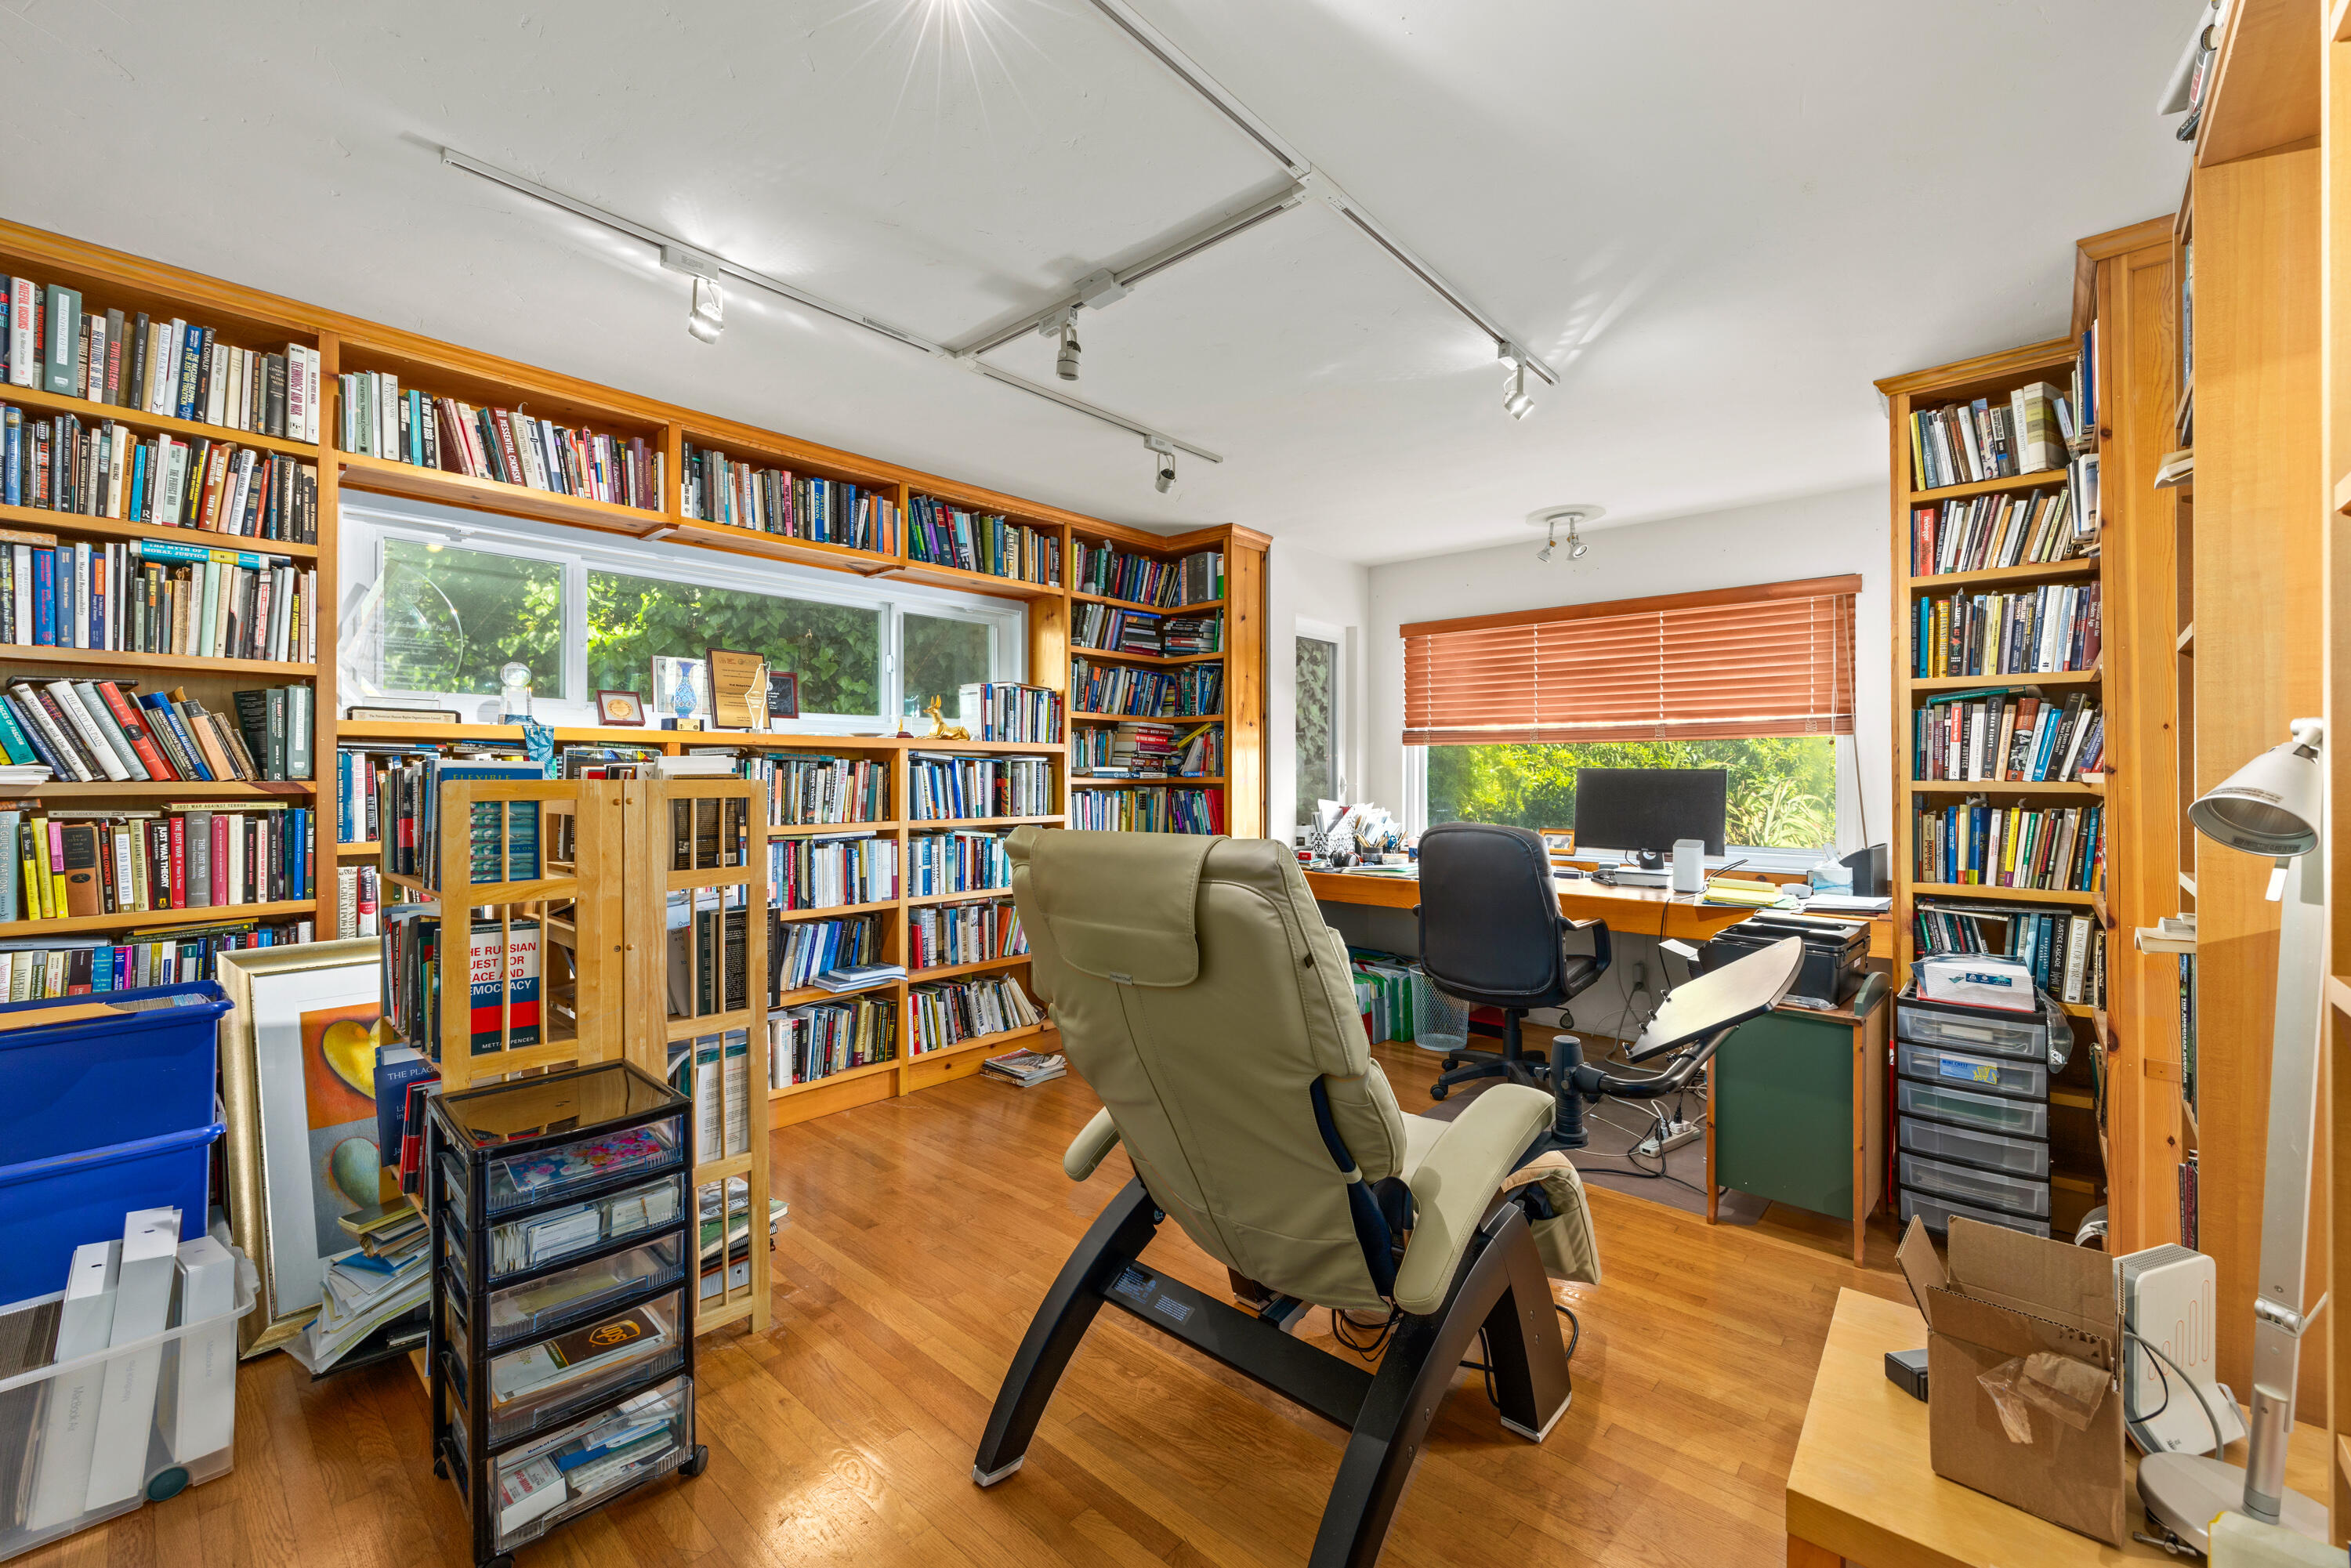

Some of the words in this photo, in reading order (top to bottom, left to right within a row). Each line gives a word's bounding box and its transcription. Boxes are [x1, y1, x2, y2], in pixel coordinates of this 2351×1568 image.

[19, 281, 30, 305] FATEFUL
[18, 306, 29, 330] VISIONS
[91, 330, 103, 365] REVOLUTIONS
[110, 342, 121, 358] CIVIL
[201, 347, 211, 371] CHIVALRY
[90, 376, 101, 389] 1848
[108, 360, 119, 391] VIOLENCE
[291, 361, 304, 391] TECHNOLOGY
[180, 382, 189, 405] TRADITION
[291, 392, 302, 403] AND
[290, 404, 302, 416] WAR
[422, 404, 432, 416] war
[423, 416, 433, 427] with
[424, 428, 434, 440] asia
[500, 424, 514, 454] ESSENTIAL
[509, 455, 522, 482] CHOMSKY
[168, 478, 178, 497] PERFECT
[1922, 516, 1931, 541] Heidegger
[174, 551, 207, 559] JUSTICE
[74, 582, 85, 616] Responsibility
[66, 693, 78, 707] THE
[90, 732, 104, 747] PAIN
[10, 726, 24, 745] FASCISM
[28, 698, 51, 726] Terrorism
[49, 728, 59, 737] and
[56, 739, 66, 748] the
[63, 749, 78, 766] Media
[103, 718, 121, 741] MODERN
[116, 741, 138, 766] THOUGHT
[1, 815, 9, 828] THE
[1, 831, 9, 851] GUILT
[159, 827, 168, 842] JUST
[118, 837, 128, 849] JUST
[119, 853, 129, 863] AND
[103, 860, 111, 885] CONSCIENCE
[120, 864, 129, 884] UNJUST
[340, 886, 349, 905] GREAT
[2077, 922, 2084, 931] IN
[2074, 933, 2084, 949] TIME
[470, 947, 481, 957] HE
[485, 942, 536, 956] RUSIAN
[2074, 951, 2082, 961] OF
[470, 958, 498, 970] UEST
[510, 956, 524, 965] OR
[2070, 962, 2081, 978] WAR
[470, 972, 495, 983] ACE
[470, 980, 532, 995] MOCACY
[387, 1070, 408, 1081] THE
[596, 1325, 627, 1342] ups
[69, 1385, 83, 1421] MacBook
